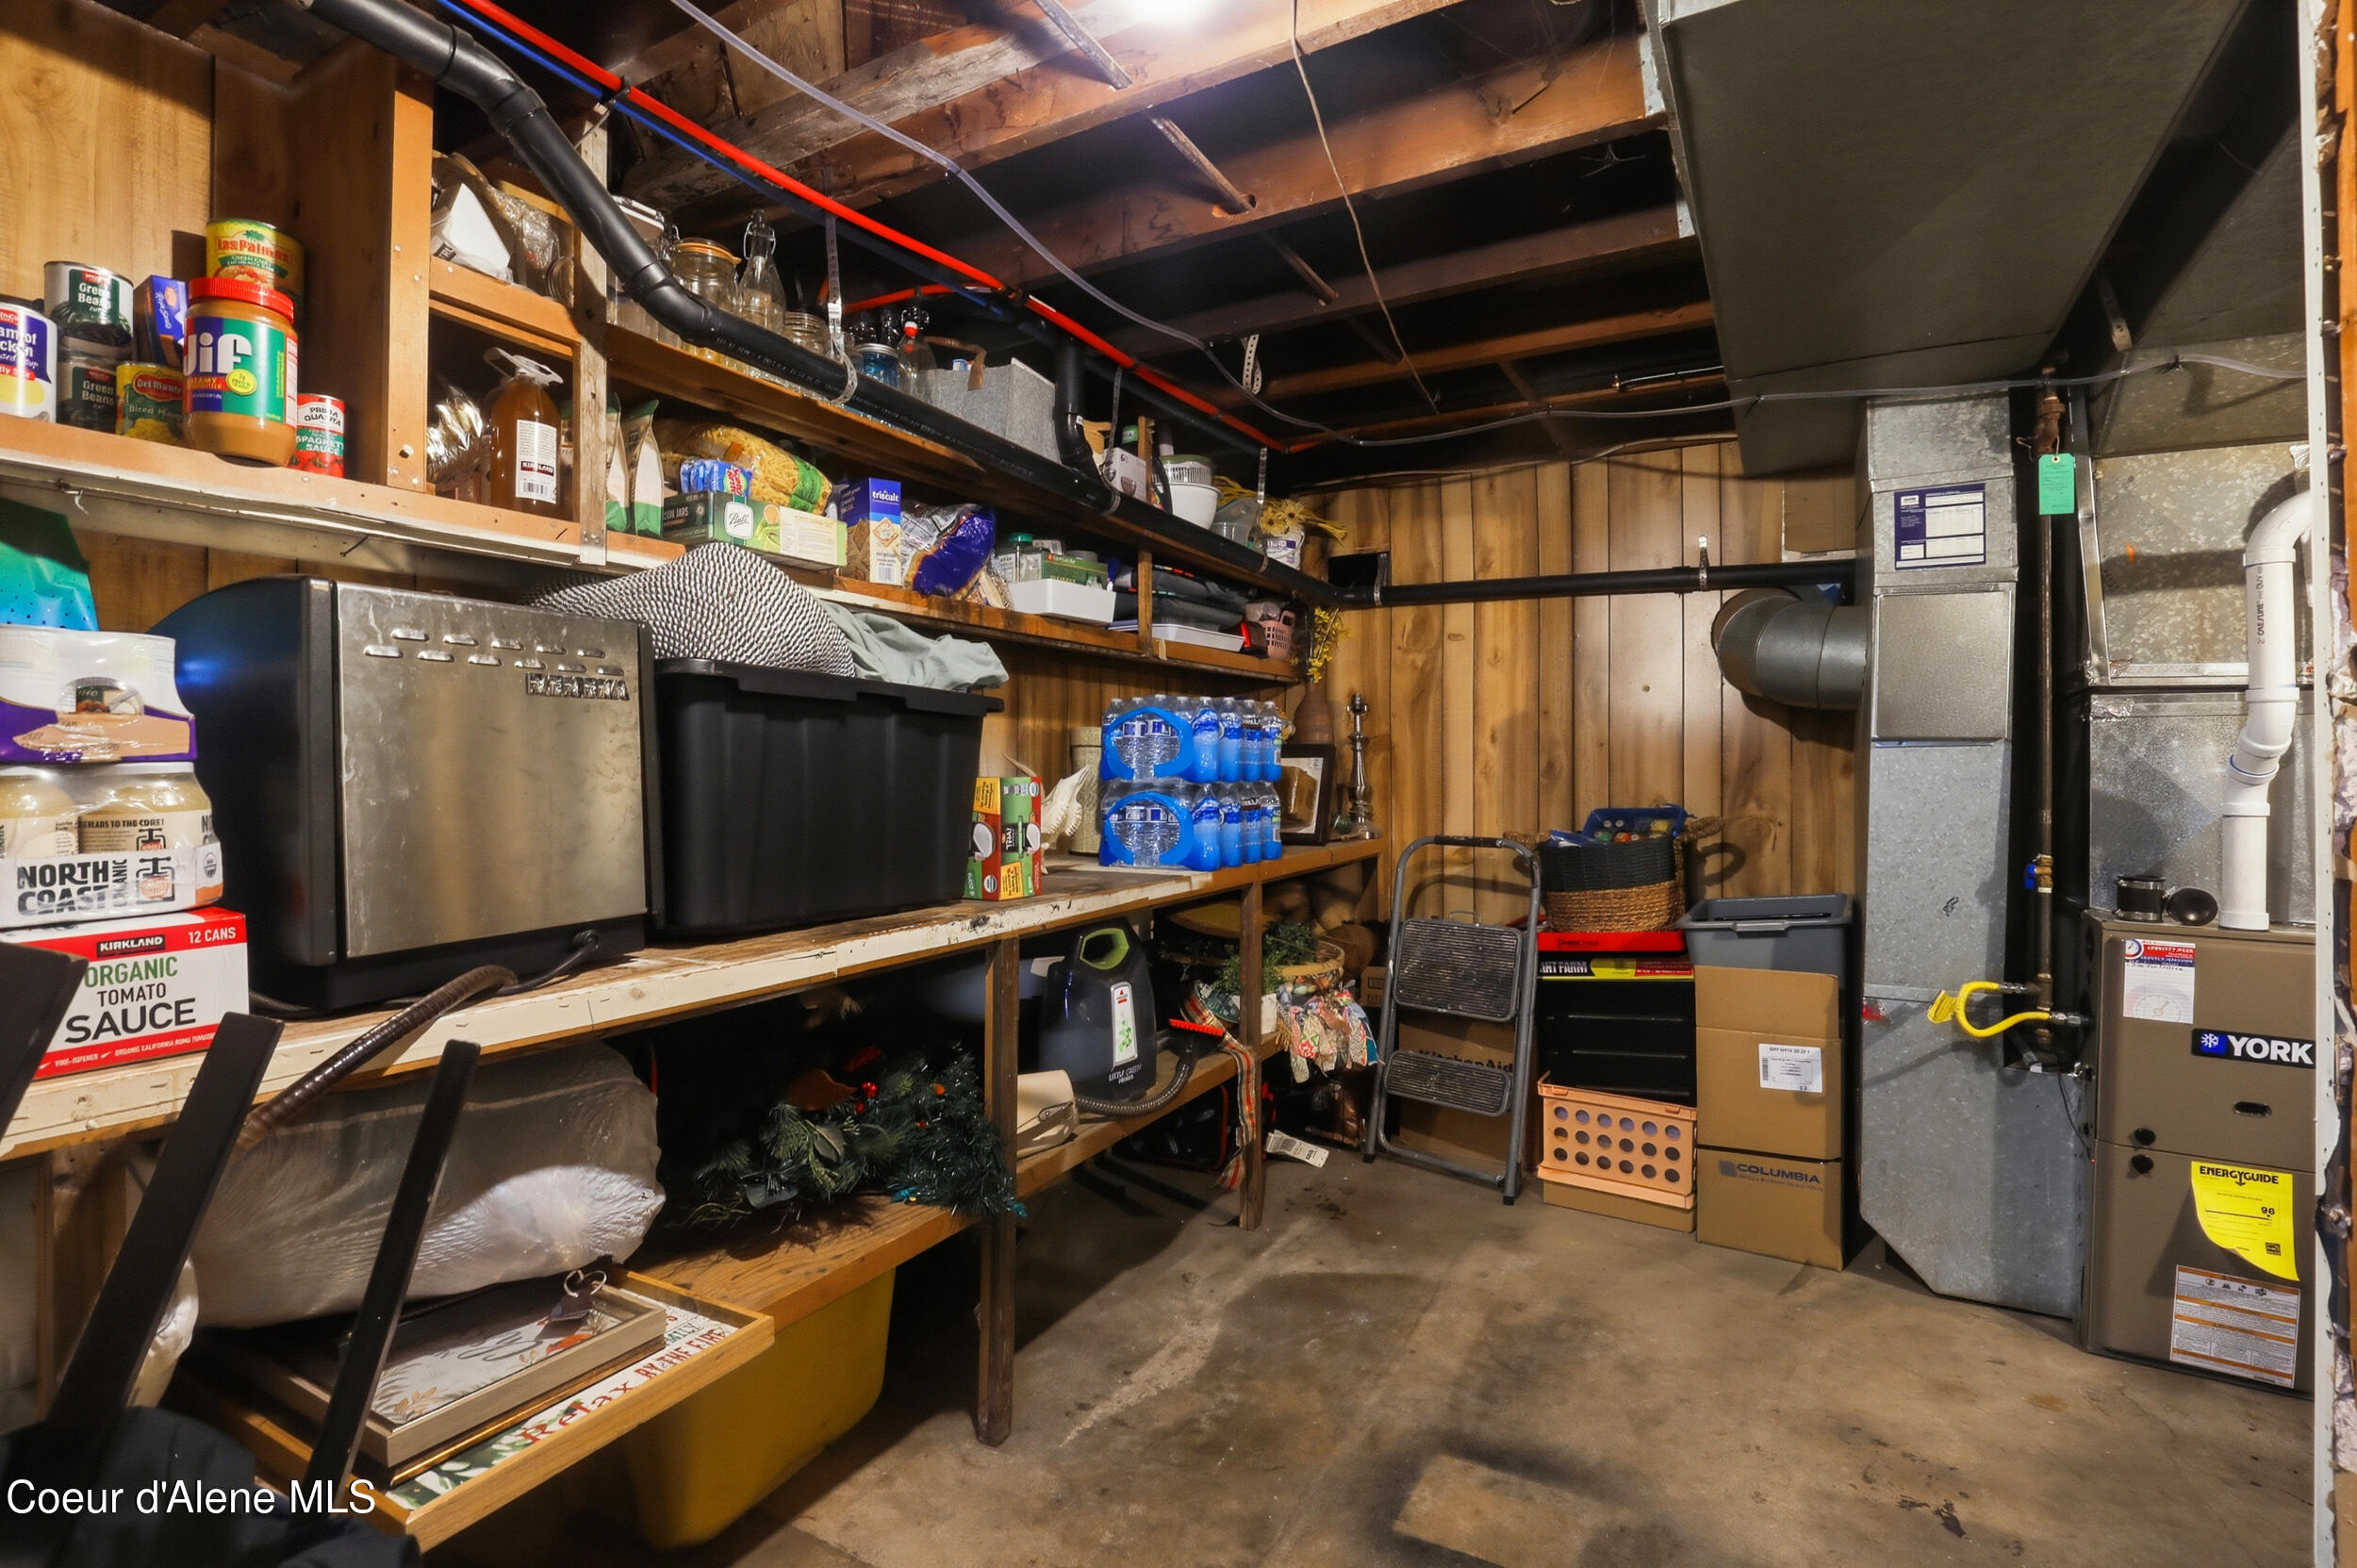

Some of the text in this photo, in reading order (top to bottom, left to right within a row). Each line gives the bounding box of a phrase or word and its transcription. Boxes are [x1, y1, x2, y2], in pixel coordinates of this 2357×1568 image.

[25, 333, 37, 346] of
[183, 332, 252, 376] Jif
[82, 380, 114, 395] Green
[137, 378, 152, 388] Del
[82, 390, 114, 406] Beans
[129, 405, 155, 415] Diced
[309, 406, 338, 419] PRIA
[304, 414, 341, 427] QUATA
[305, 443, 341, 456] SAUCE
[872, 489, 899, 503] triscuit
[110, 819, 121, 828] TO
[123, 819, 138, 828] THE
[17, 859, 109, 889] NORTH
[17, 884, 109, 916] COAST
[99, 935, 164, 952] KIRKLAND
[188, 926, 237, 944] 12 CANS
[84, 956, 178, 988] ORGANIC
[1558, 961, 1588, 974] FARM
[97, 982, 167, 1008] TOMATO
[64, 998, 196, 1044] SAUCE
[114, 1046, 140, 1057] ORGANIC
[140, 1039, 174, 1053] CALIFORNIA
[174, 1035, 190, 1047] ROMA
[191, 1032, 216, 1044] TOMATO
[2227, 1035, 2314, 1065] YORK
[1419, 1048, 1514, 1070] henAid
[1737, 1164, 1821, 1184] COLUMBIA
[2199, 1165, 2280, 1186] ENERGYGUIDE
[666, 1322, 705, 1344] MILY
[517, 1328, 725, 1444] Relax BY THE FIRE
